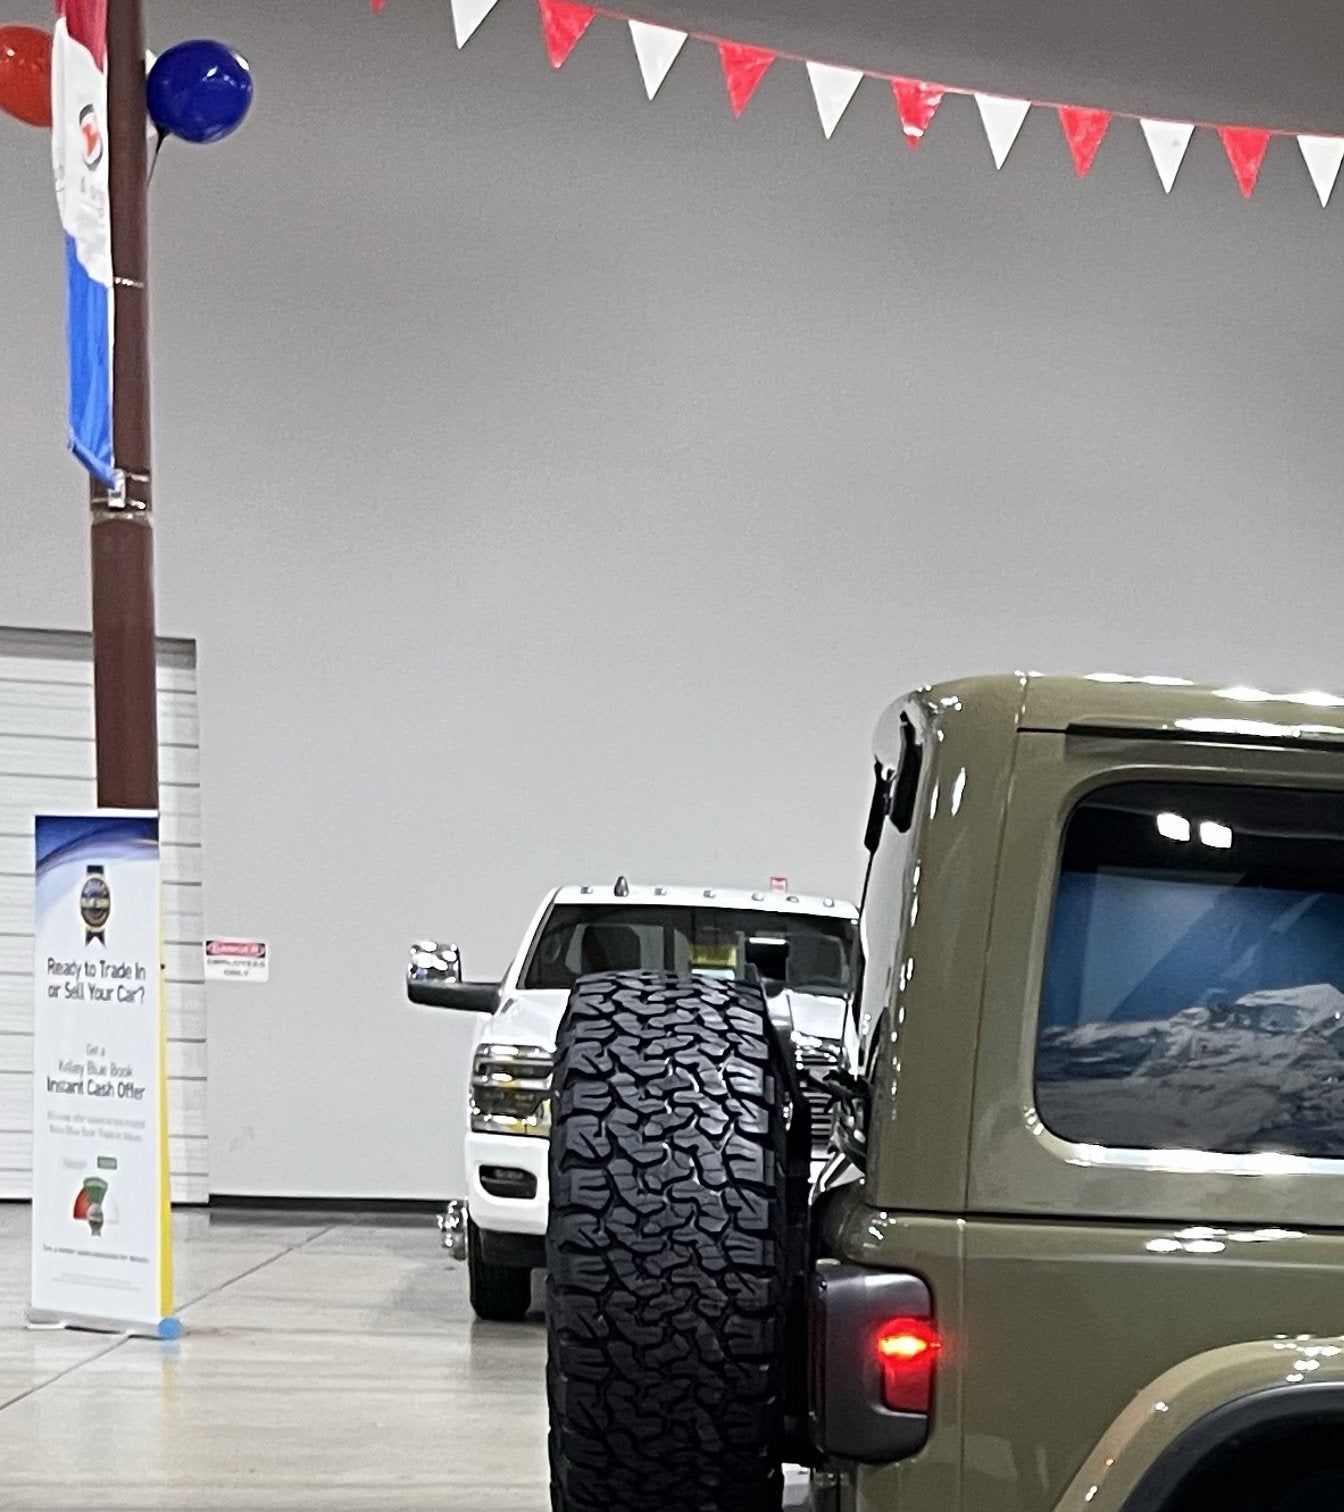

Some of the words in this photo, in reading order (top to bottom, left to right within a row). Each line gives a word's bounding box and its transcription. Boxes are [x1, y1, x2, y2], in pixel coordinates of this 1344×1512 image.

[47, 957, 82, 981] Ready
[85, 961, 97, 978] to
[99, 960, 132, 980] Trade
[134, 962, 146, 981] In
[48, 984, 61, 998] or
[64, 982, 84, 1000] Sell
[88, 984, 114, 1001] Your
[117, 985, 145, 1005] Car?
[87, 1078, 114, 1097] Cash
[117, 1081, 146, 1101] Offer
